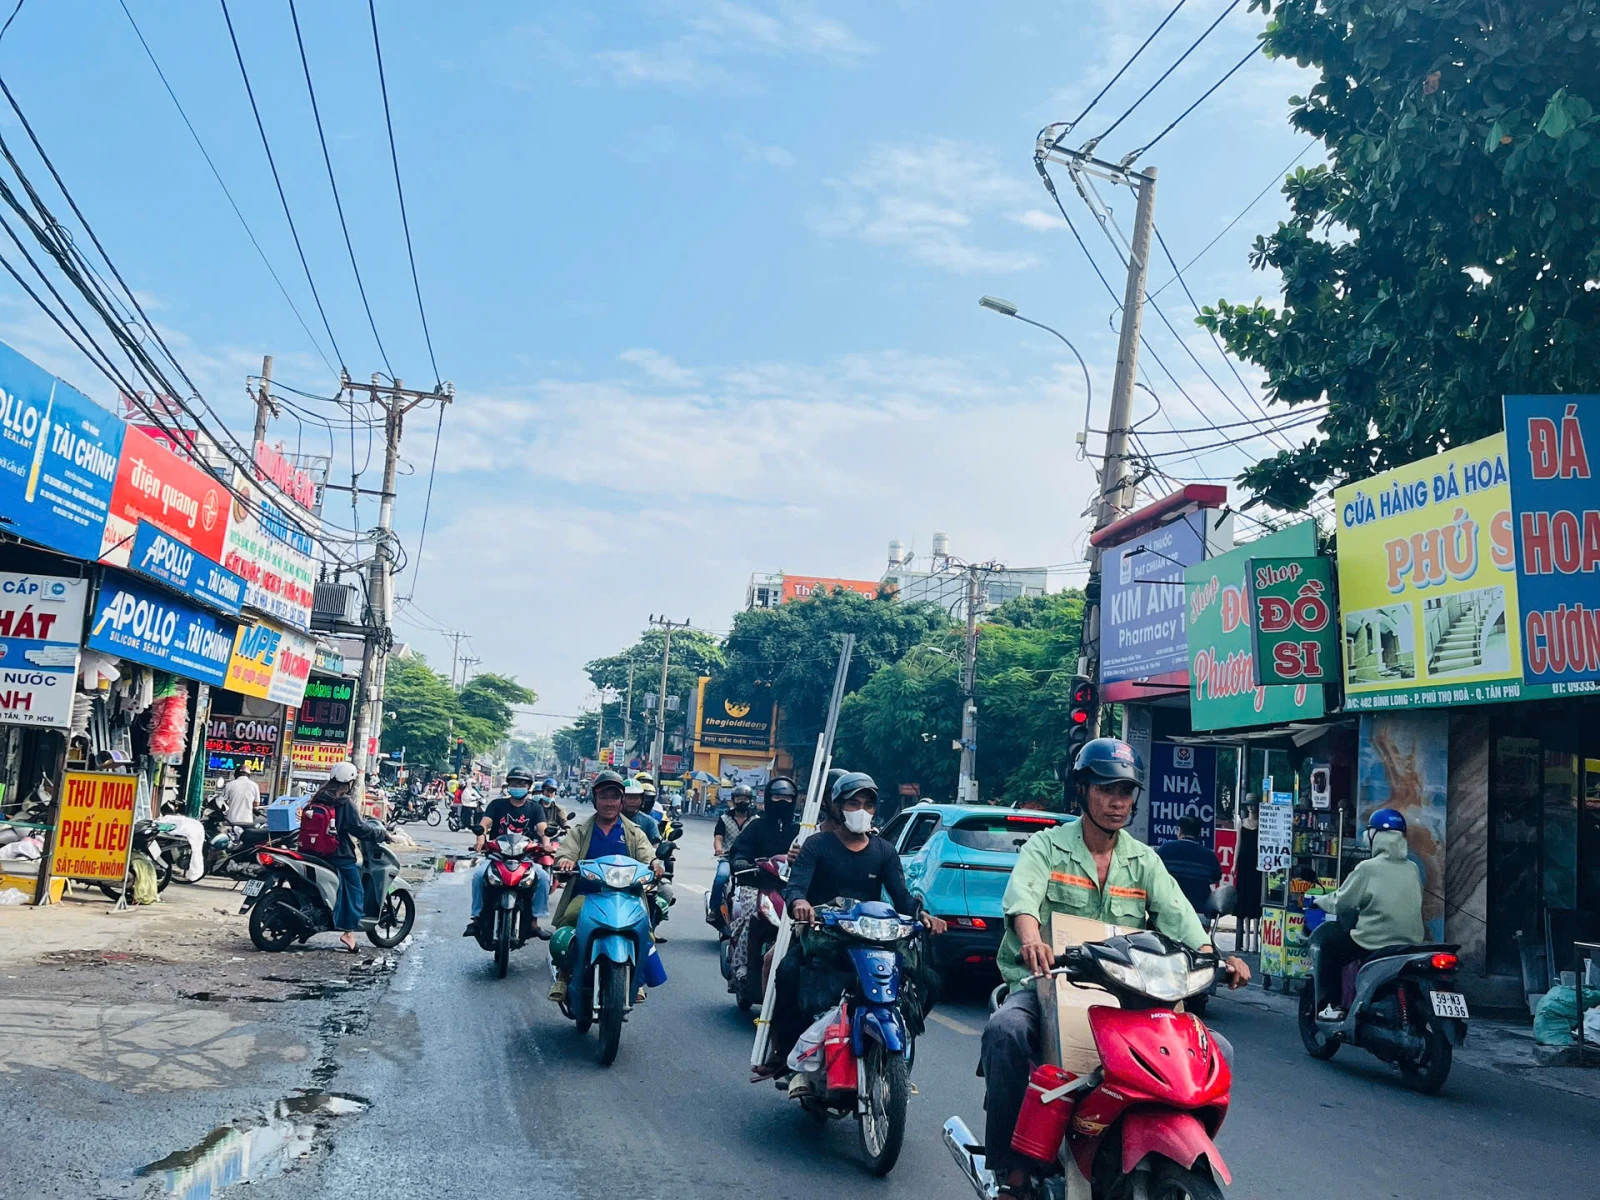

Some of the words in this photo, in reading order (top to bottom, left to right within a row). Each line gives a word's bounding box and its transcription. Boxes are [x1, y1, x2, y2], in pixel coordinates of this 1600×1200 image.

[3, 429, 34, 450] SEALANT
[51, 422, 76, 461] TÀI
[74, 442, 117, 483] CHÍNH
[1528, 404, 1591, 480] ĐÁ
[129, 458, 160, 499] điện
[161, 484, 199, 529] quang
[1343, 492, 1377, 530] CỬA
[1379, 481, 1429, 520] HÀNG
[1432, 462, 1460, 503] ĐÁ
[1463, 455, 1508, 494] HOA
[1153, 531, 1173, 552] THUỐC
[1385, 507, 1480, 595] PHÚ
[1520, 510, 1600, 575] HOA
[141, 535, 192, 580] APOLLO
[3, 577, 39, 595] CẤP
[151, 565, 169, 581] SILICONE
[169, 574, 187, 587] SEALANT
[219, 576, 240, 603] CHÍNH
[1256, 562, 1303, 590] Shop
[1111, 584, 1142, 626] KIM
[1146, 571, 1186, 616] ANH
[1190, 575, 1219, 624] Shop
[1258, 578, 1330, 633] ĐỒ
[93, 590, 176, 647] APOLLO
[1119, 618, 1177, 649] Pharmacy
[1180, 612, 1185, 633] 1
[109, 630, 141, 649] SILICONE
[143, 643, 170, 659] SEALANT
[188, 617, 203, 656] TÀI
[200, 627, 232, 664] CHÍNH
[237, 623, 282, 667] MPE
[1273, 641, 1324, 678] SI
[4, 672, 57, 687] NƯỚC
[333, 684, 351, 700] CÁO
[1373, 694, 1389, 707] BÌNH
[1390, 694, 1408, 706] LONG
[1414, 693, 1421, 704] P.
[1421, 690, 1437, 703] PHÚ
[1438, 692, 1452, 706] THỌ
[1453, 690, 1469, 702] HOÀ
[1476, 690, 1485, 701] Q.
[1485, 685, 1502, 699] TÂN
[1503, 682, 1520, 698] PHÚ
[301, 700, 347, 725] LED
[705, 718, 767, 730] thegioididong
[235, 720, 278, 742] CÔNG
[319, 747, 344, 755] MUA
[67, 779, 97, 808] THU
[99, 782, 133, 811] MUA
[1163, 771, 1202, 795] NHÀ
[1151, 796, 1214, 823] THUỐC
[60, 814, 95, 849] PHẾ
[94, 818, 130, 856] LIỆU
[1153, 824, 1177, 836] KIM
[1259, 843, 1291, 856] MÍA
[1262, 920, 1282, 947] Mía
[1101, 1086, 1124, 1101] HONDA
